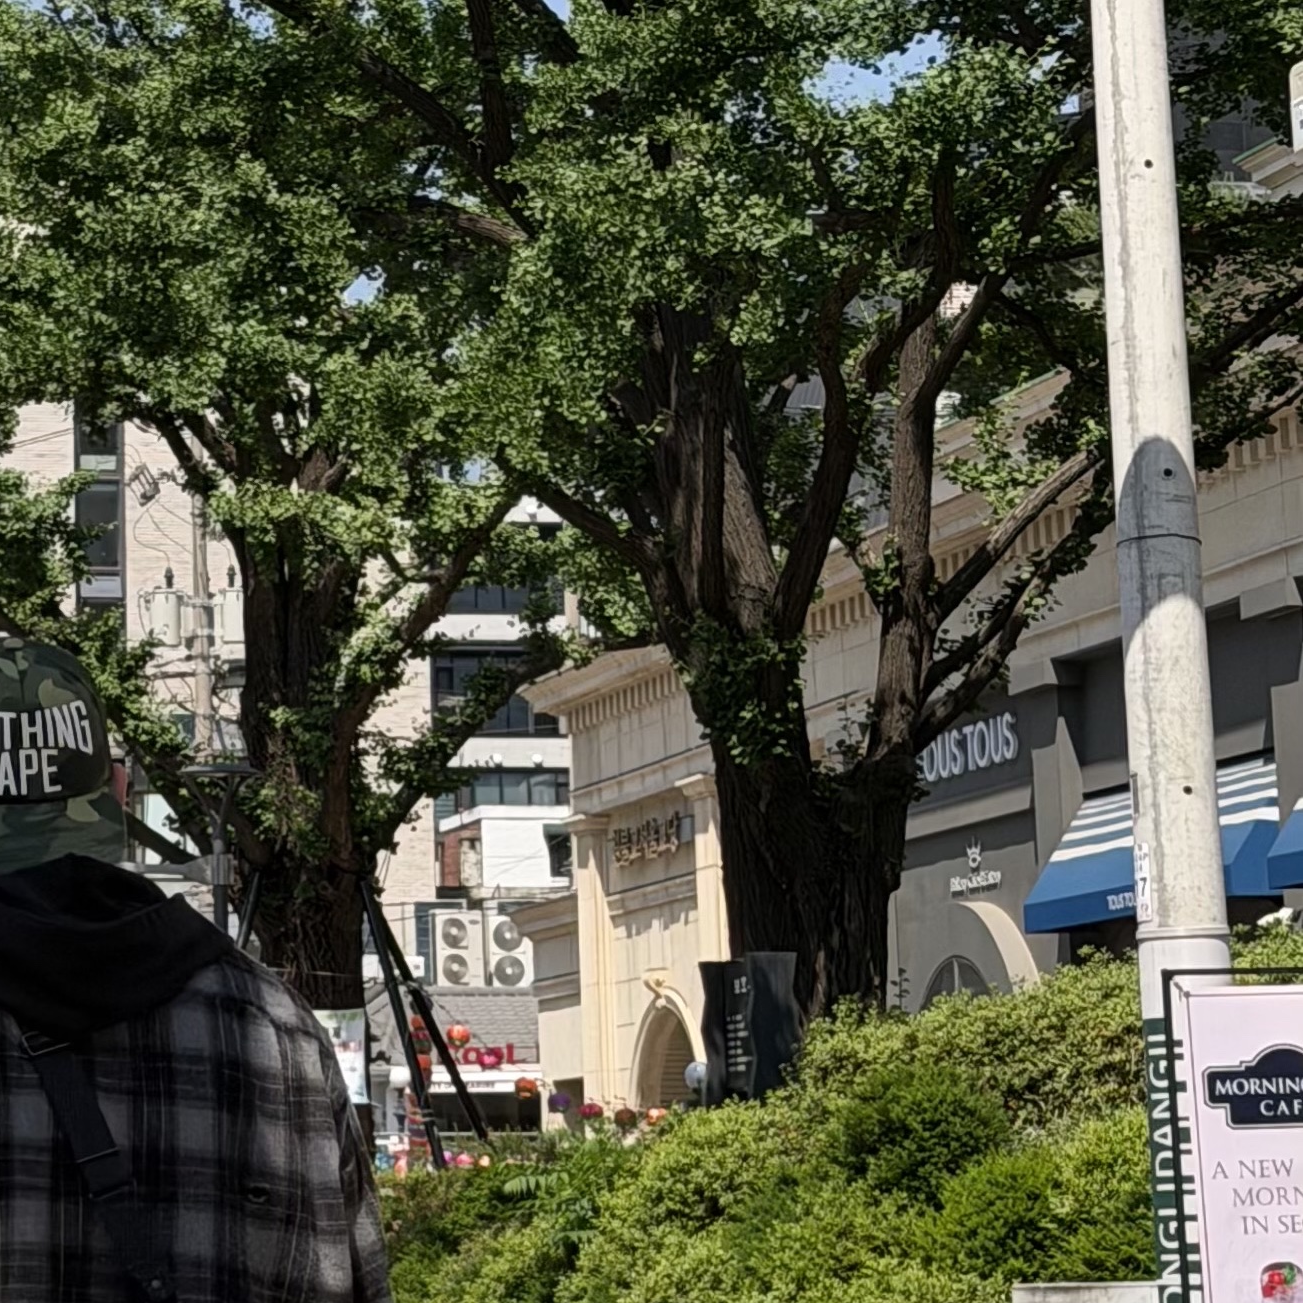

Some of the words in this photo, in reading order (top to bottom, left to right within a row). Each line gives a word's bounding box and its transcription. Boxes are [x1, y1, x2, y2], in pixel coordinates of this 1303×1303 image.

[962, 711, 1018, 771] TOUS
[1214, 1076, 1303, 1096] MORNIN
[1211, 1160, 1229, 1180] A
[1238, 1158, 1294, 1179] NEW
[1241, 1214, 1269, 1236] IN
